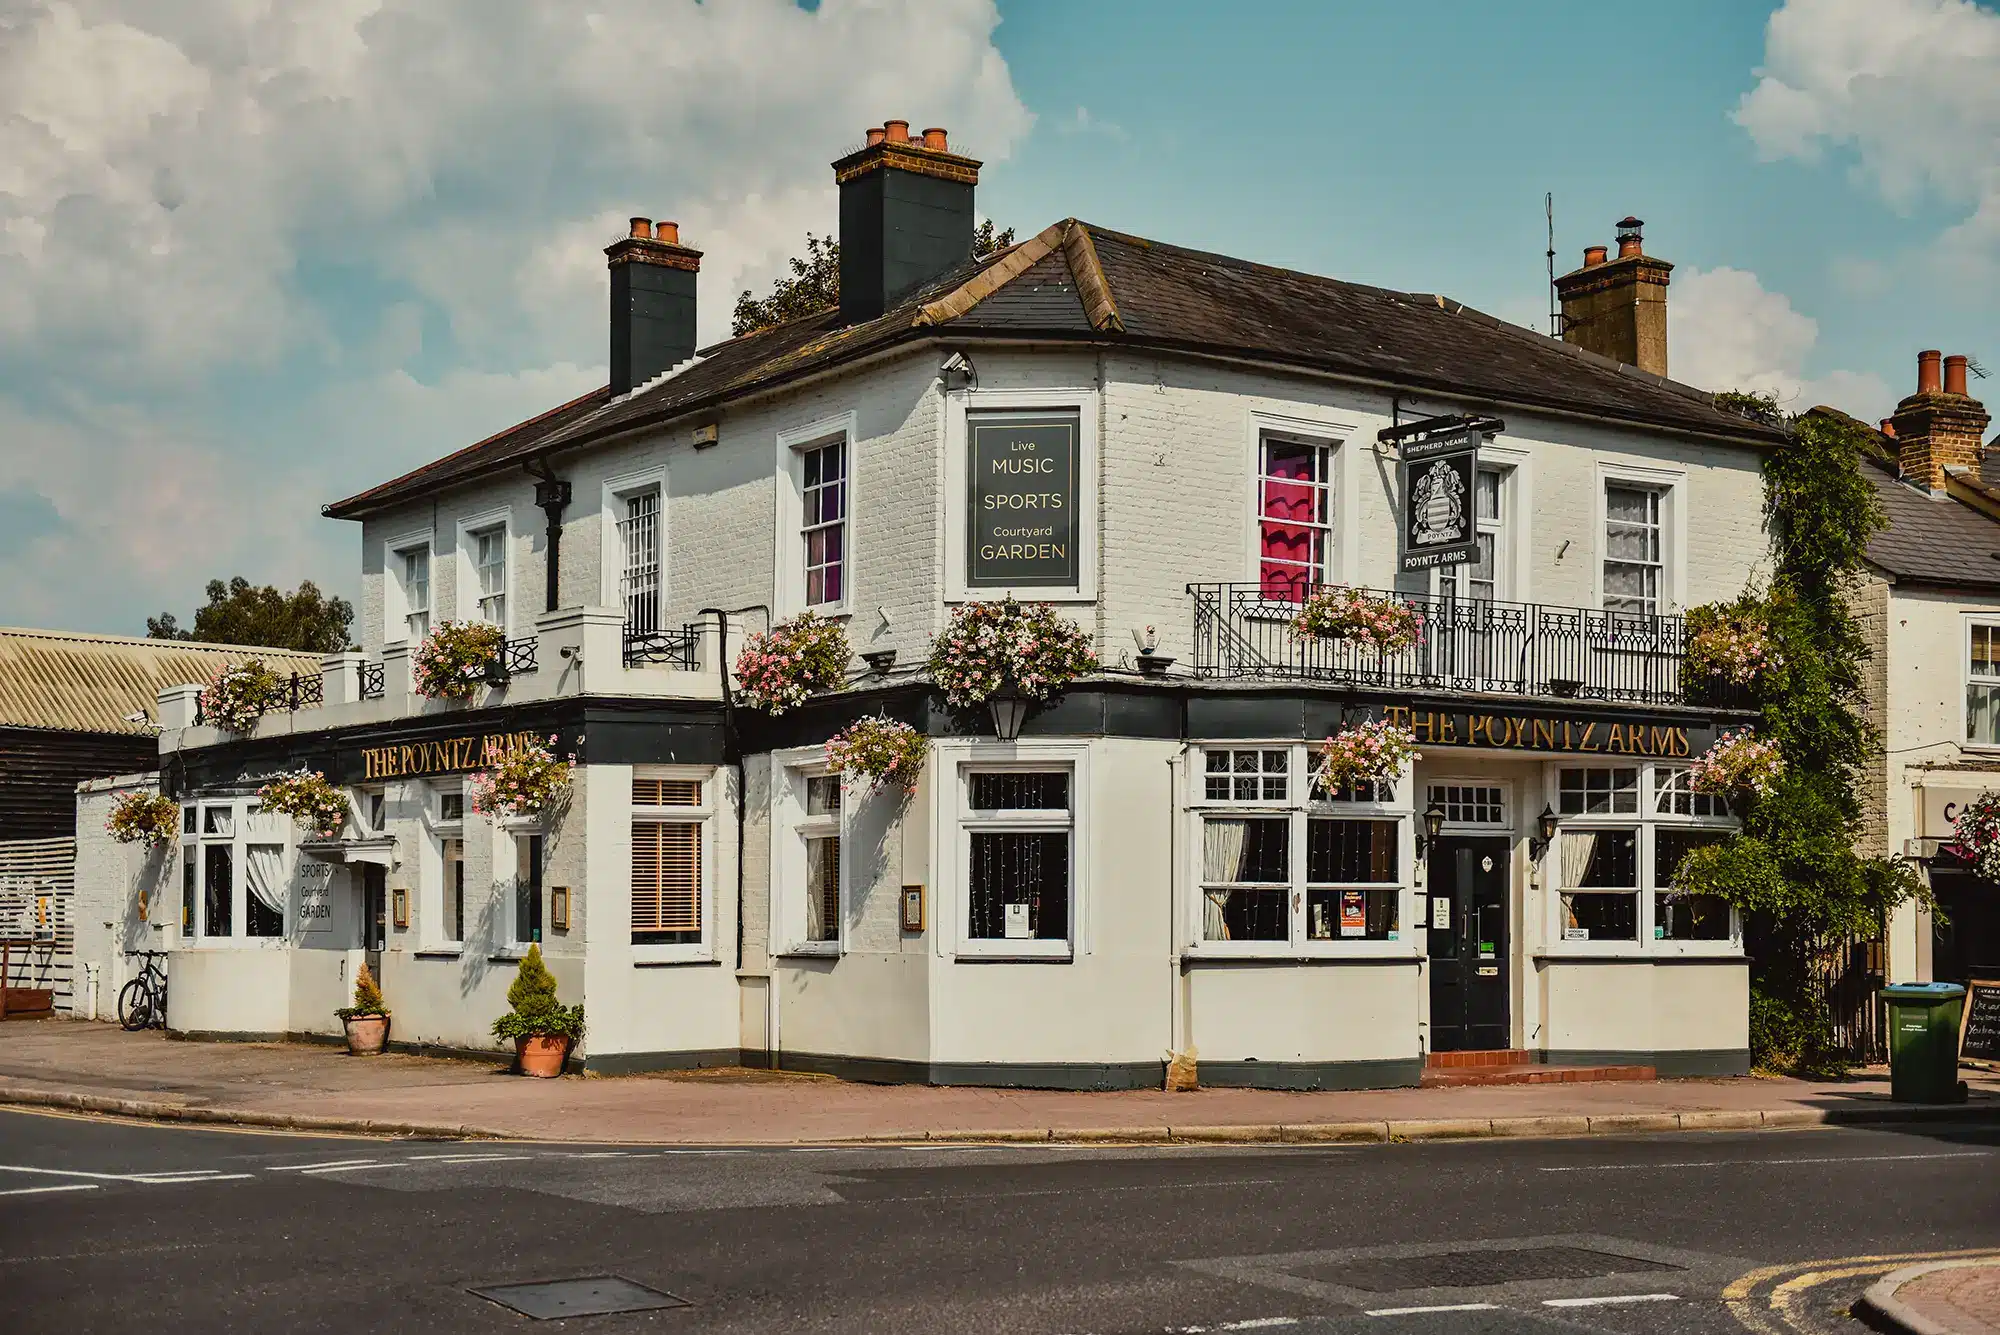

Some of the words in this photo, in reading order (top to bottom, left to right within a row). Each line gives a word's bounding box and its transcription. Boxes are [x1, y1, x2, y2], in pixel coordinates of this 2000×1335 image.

[1011, 441, 1036, 451] Live
[1406, 442, 1443, 454] SHEPHERD
[1444, 436, 1469, 448] NEAME
[992, 458, 1054, 474] MUSIC
[984, 493, 1062, 510] SPORTS
[993, 526, 1053, 538] Courtyard
[1427, 531, 1453, 540] POYNTZ
[980, 543, 1065, 560] GARDEN
[1405, 554, 1439, 568] POYNTZ
[1440, 550, 1467, 563] ARMS
[1383, 705, 1458, 744] THE
[1466, 714, 1600, 752] POYNTZ
[1605, 722, 1690, 757] ARMS
[361, 746, 399, 779] THE
[400, 737, 475, 775] POYNTZ
[301, 864, 330, 878] SPORTS
[300, 905, 331, 919] GARDEN
